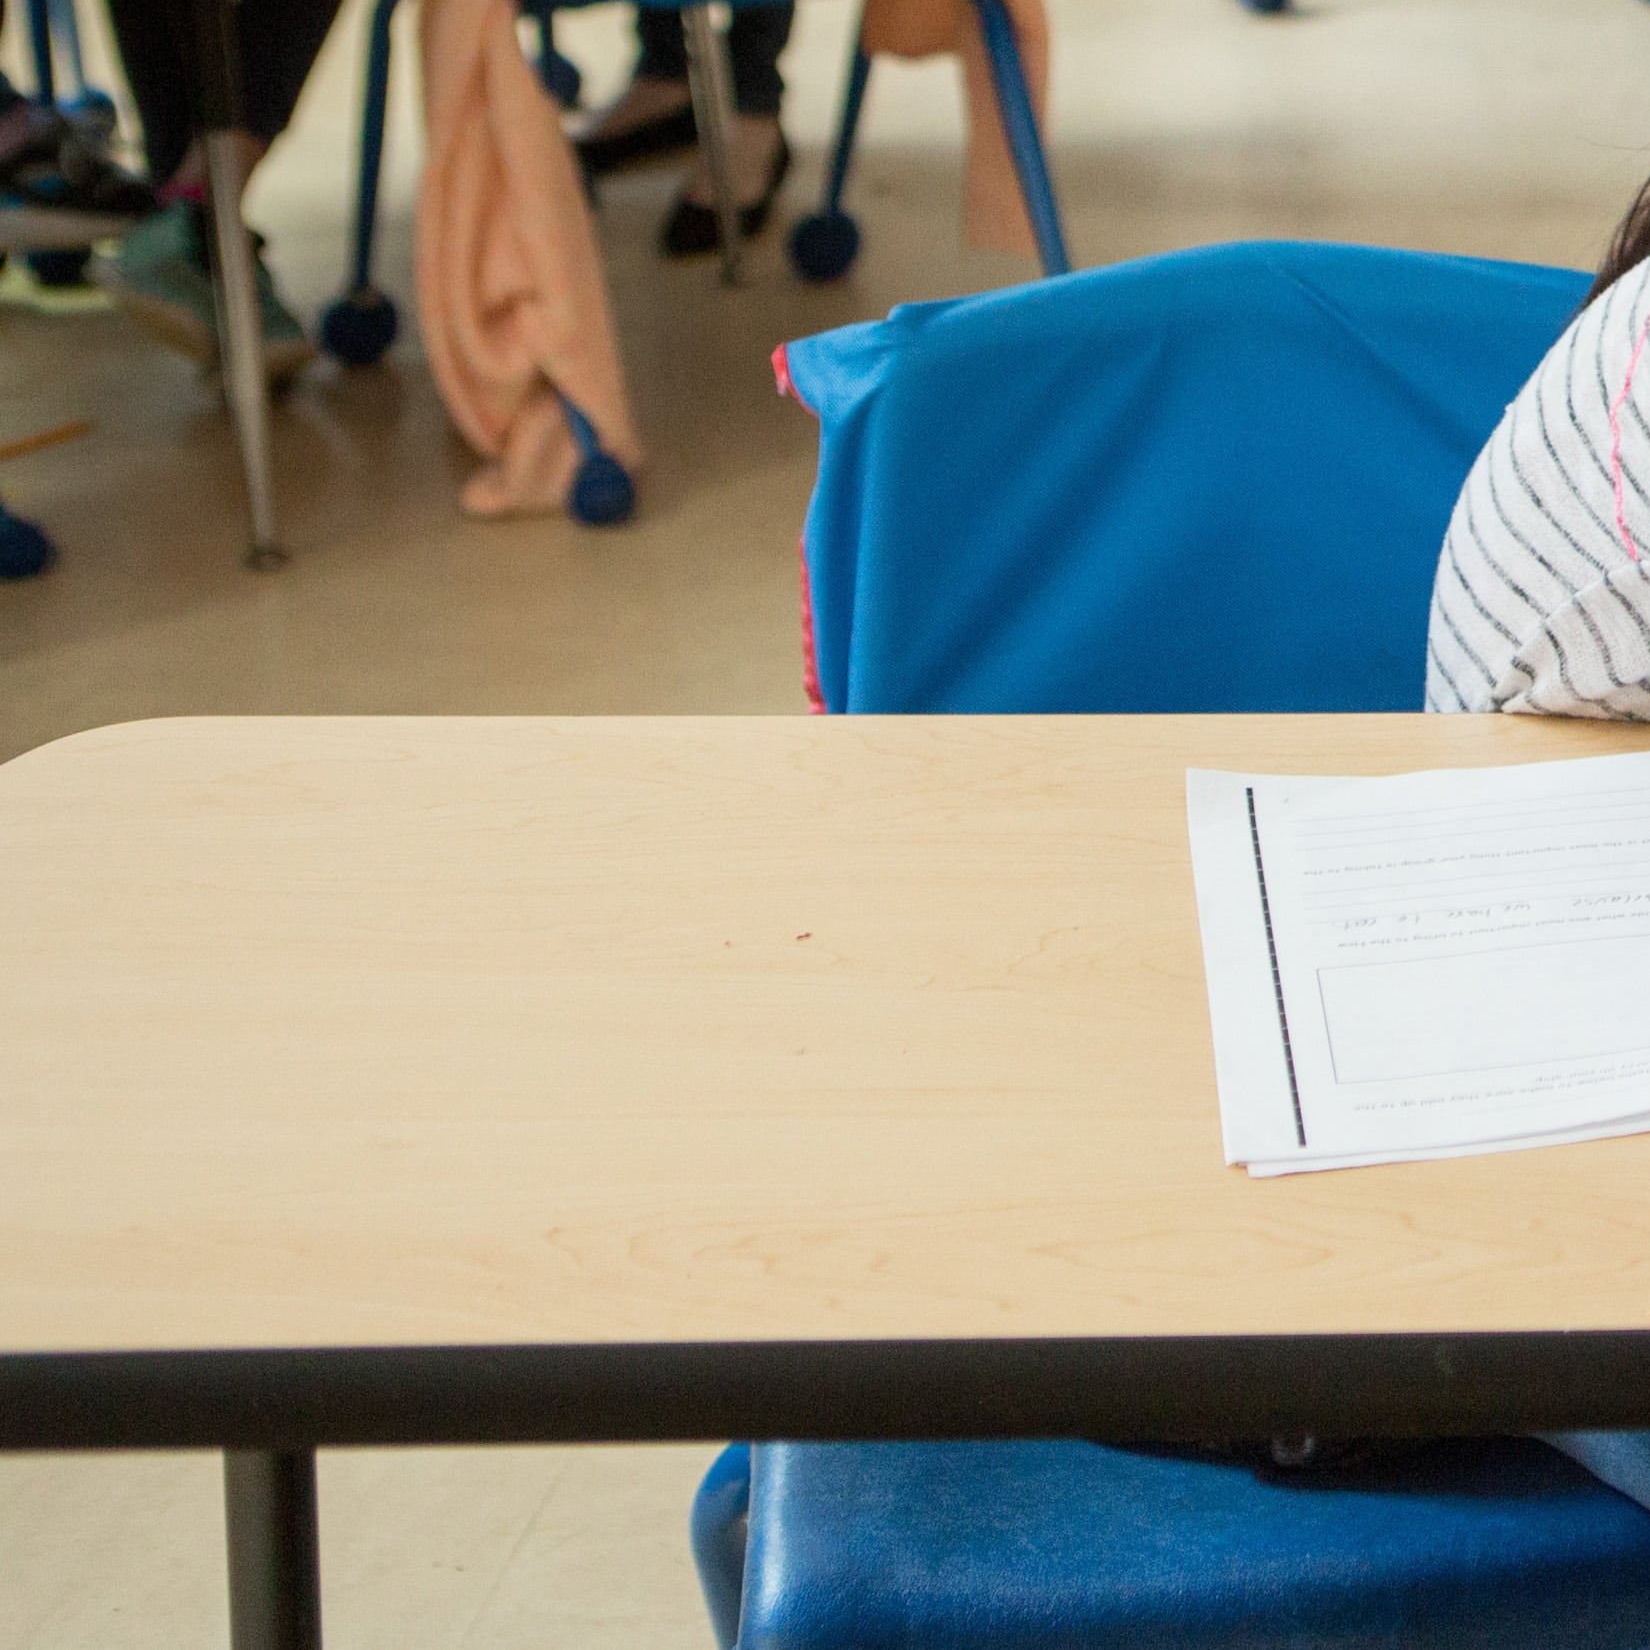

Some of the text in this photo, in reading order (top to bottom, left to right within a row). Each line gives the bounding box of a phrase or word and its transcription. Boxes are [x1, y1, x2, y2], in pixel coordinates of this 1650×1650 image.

[1506, 846, 1565, 856] important
[1401, 858, 1435, 866] group
[1504, 904, 1530, 912] we
[1469, 922, 1530, 934] important
